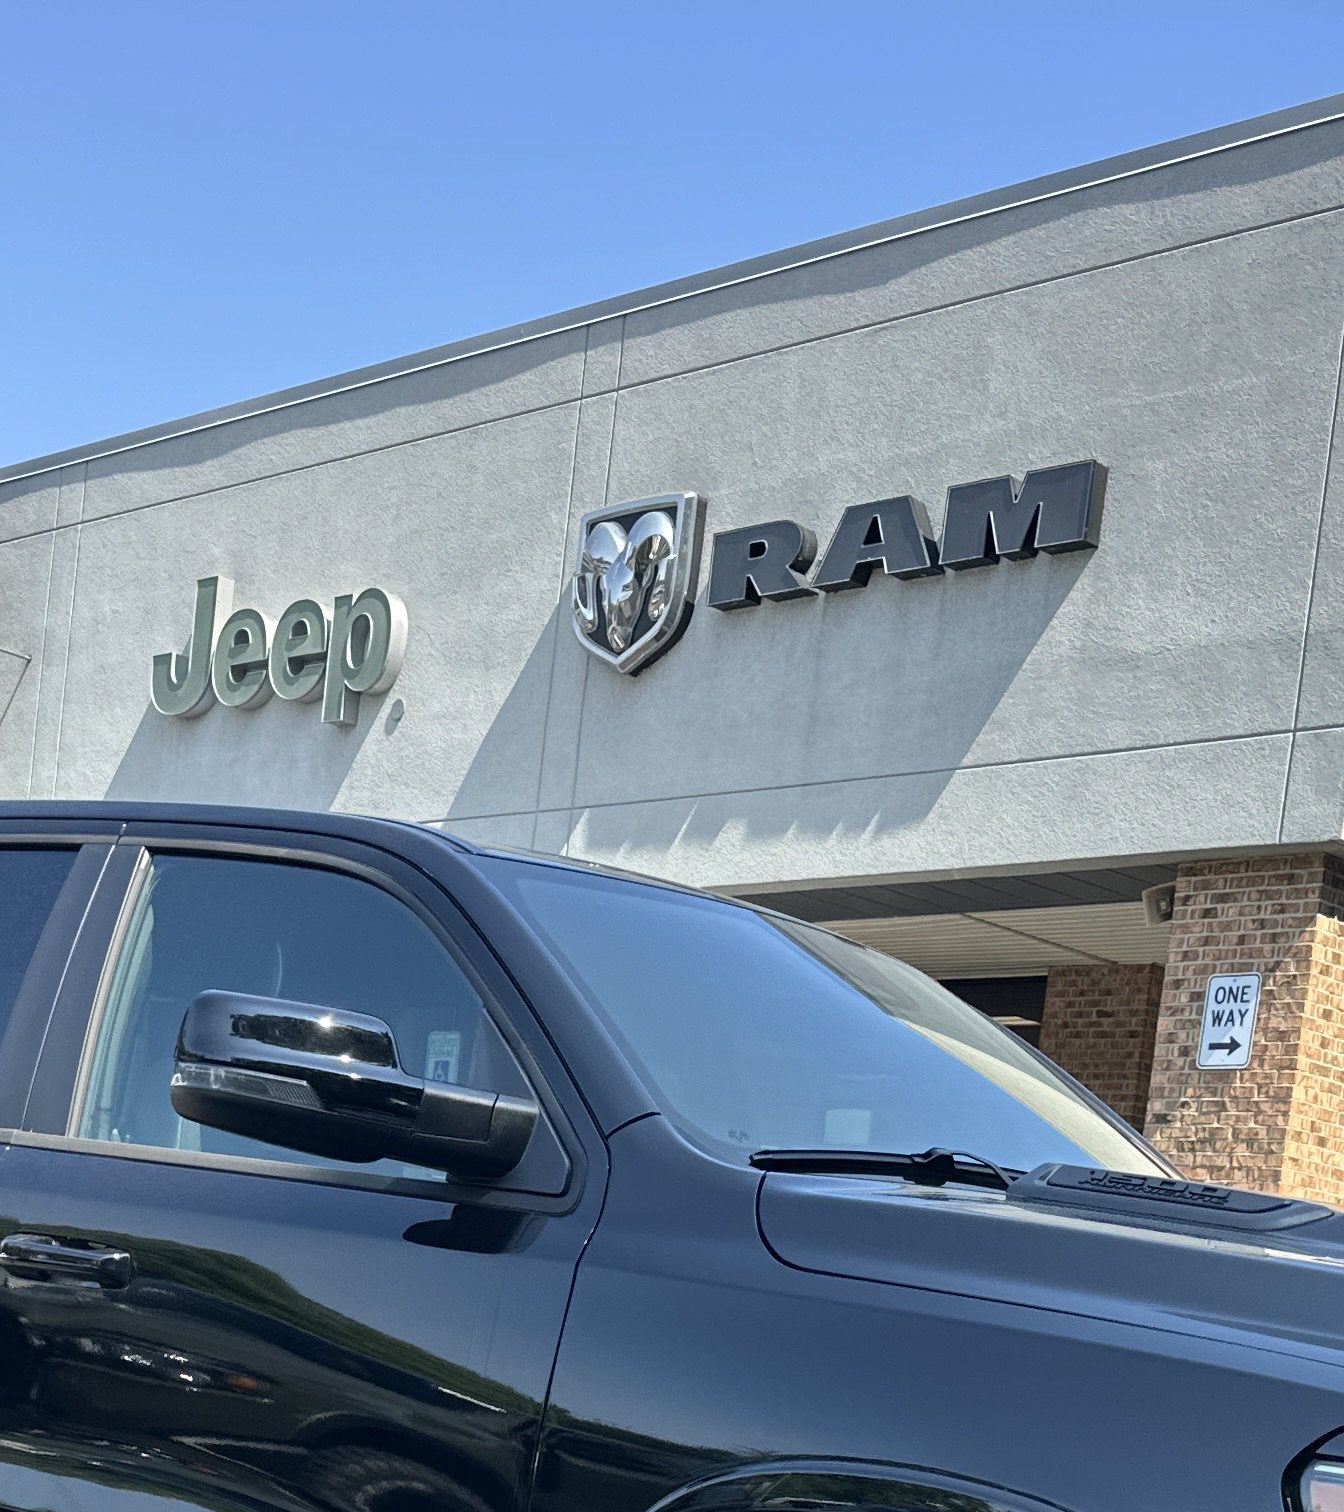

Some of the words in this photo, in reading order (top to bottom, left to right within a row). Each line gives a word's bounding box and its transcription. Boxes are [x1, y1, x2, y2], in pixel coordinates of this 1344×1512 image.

[707, 459, 1109, 611] RAM
[151, 576, 408, 727] Jeep
[1211, 1008, 1249, 1027] WAY
[1214, 985, 1251, 1004] ONE
